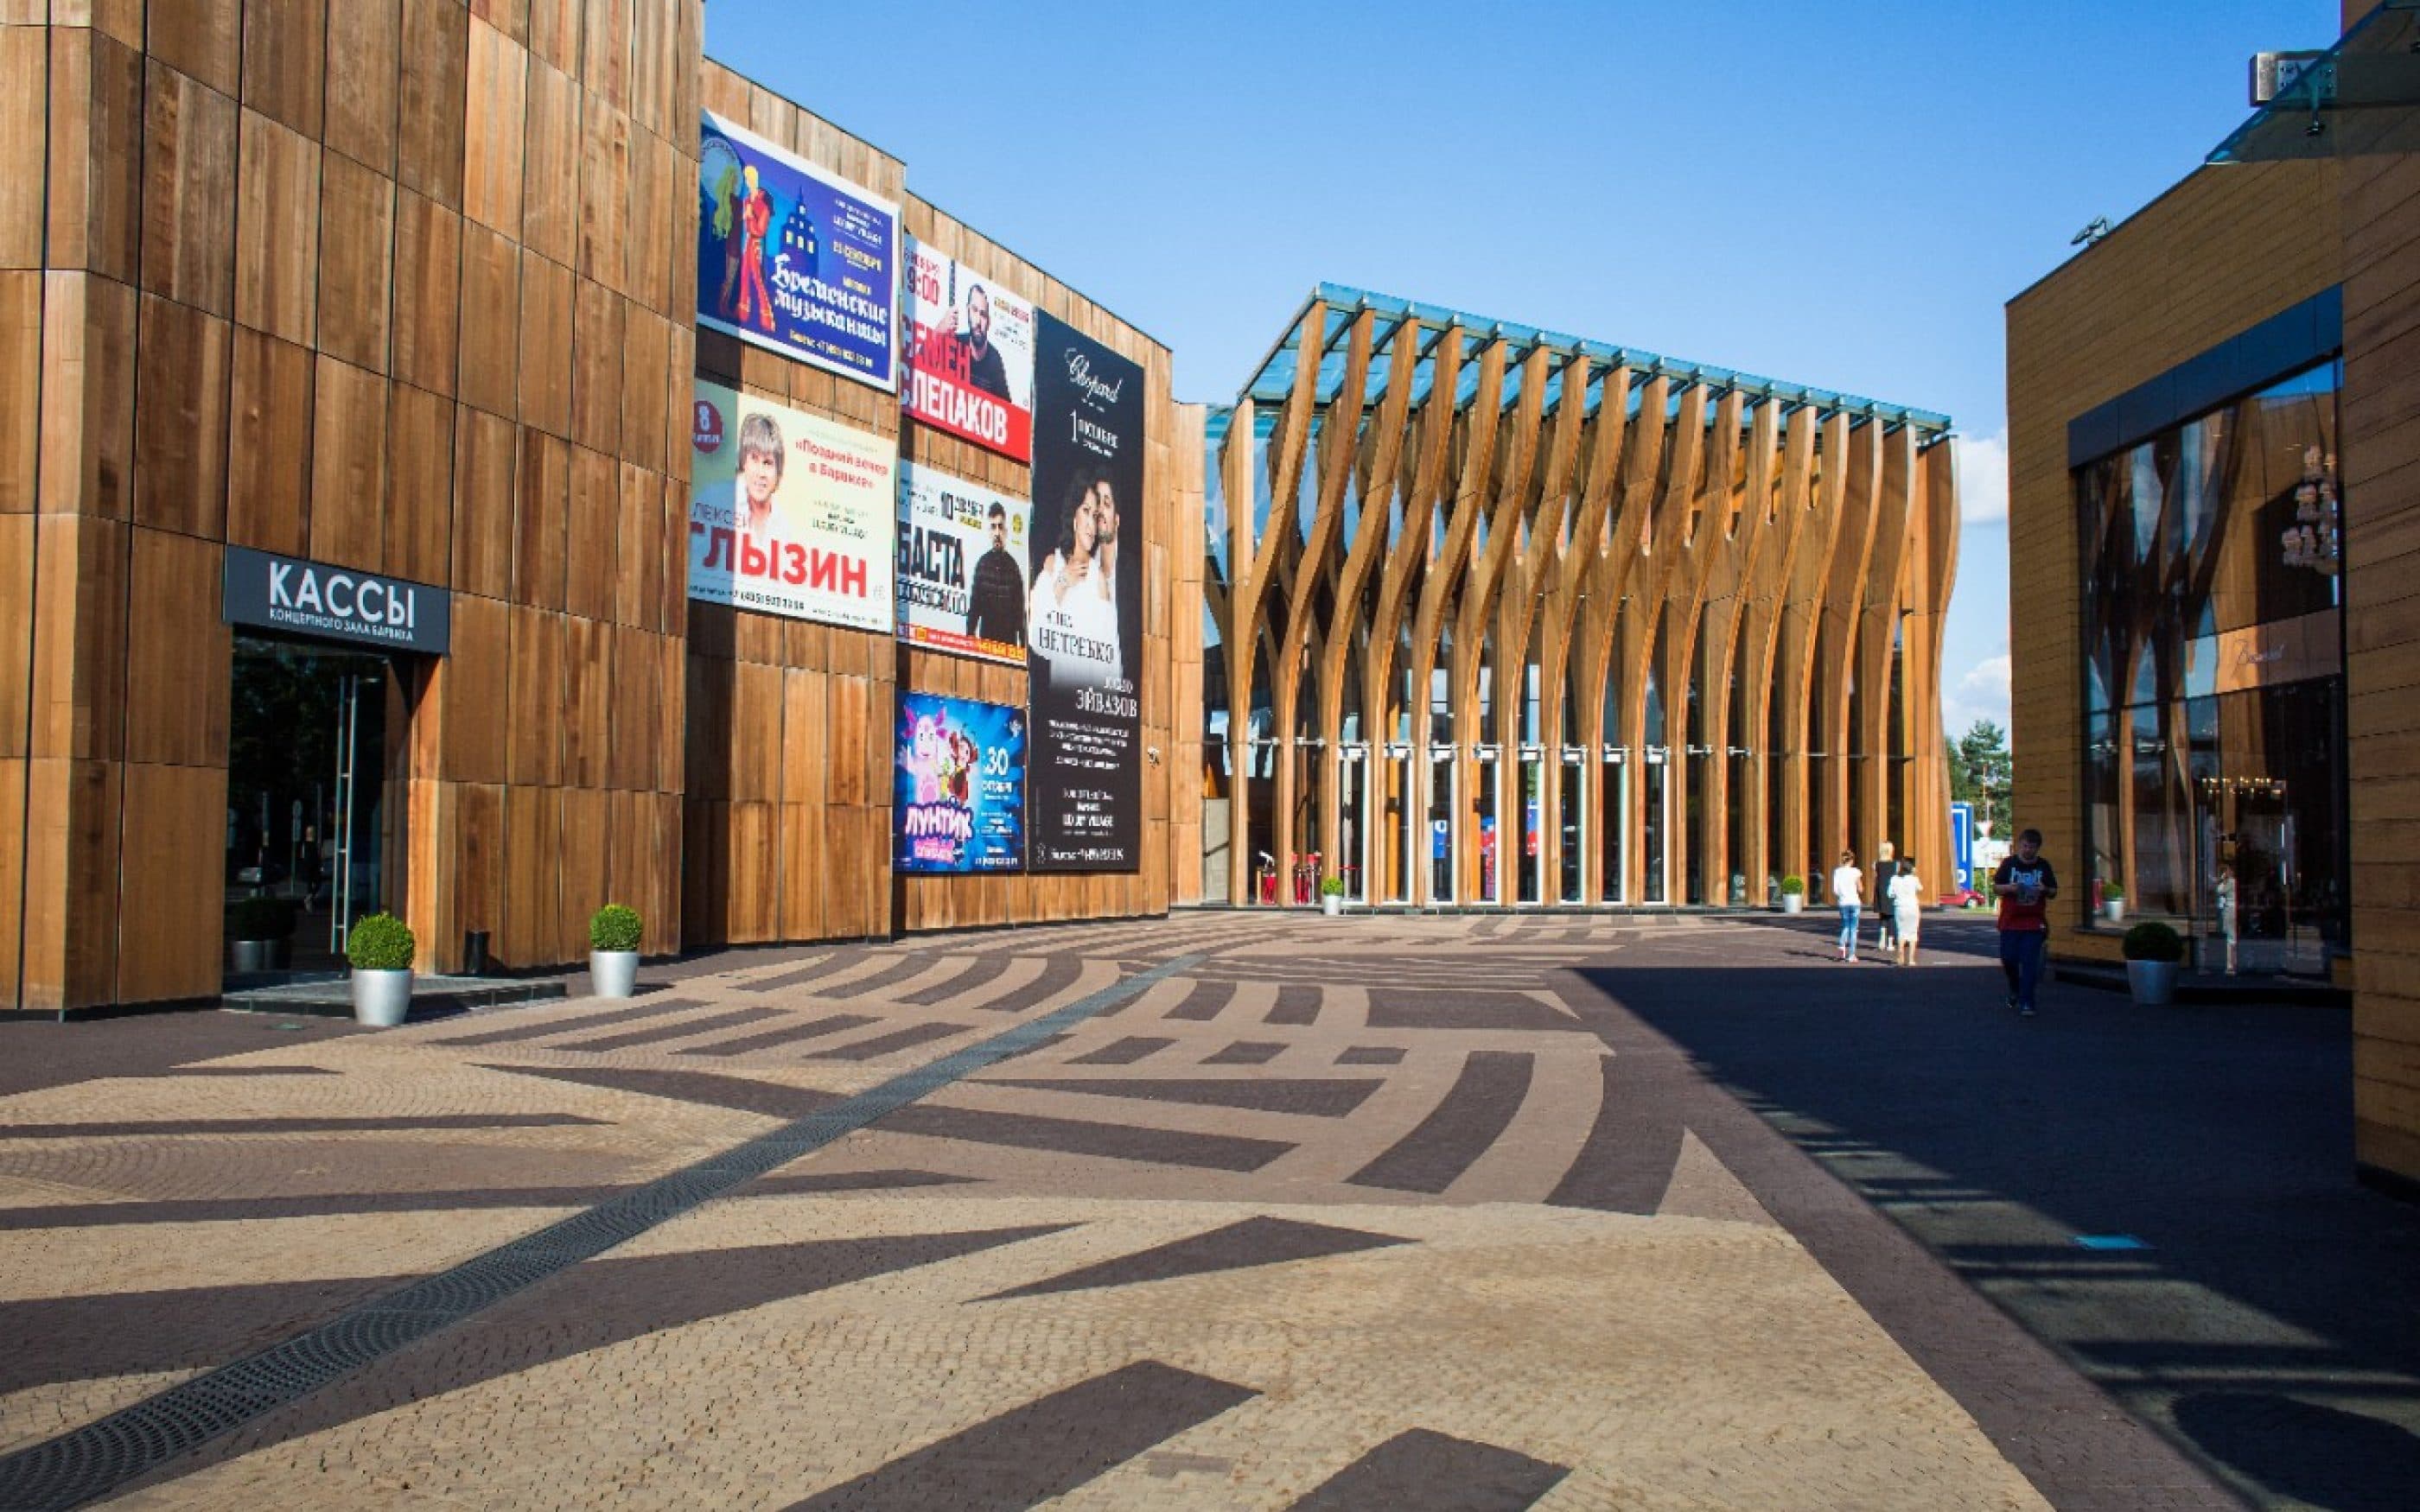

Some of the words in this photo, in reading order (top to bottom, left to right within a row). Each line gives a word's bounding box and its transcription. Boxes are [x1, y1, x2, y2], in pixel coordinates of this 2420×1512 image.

[897, 519, 965, 590] БАСТА
[269, 561, 415, 628] КАССЫ
[270, 607, 342, 631] КОНЦЕРТНОГО
[344, 618, 371, 636] ЗАЛА
[1039, 626, 1114, 664] НЕТРЕБКО
[1075, 686, 1137, 718] ЭЙВАЗОВ
[984, 746, 1009, 776] 30
[905, 804, 973, 842] ЛУНТИК
